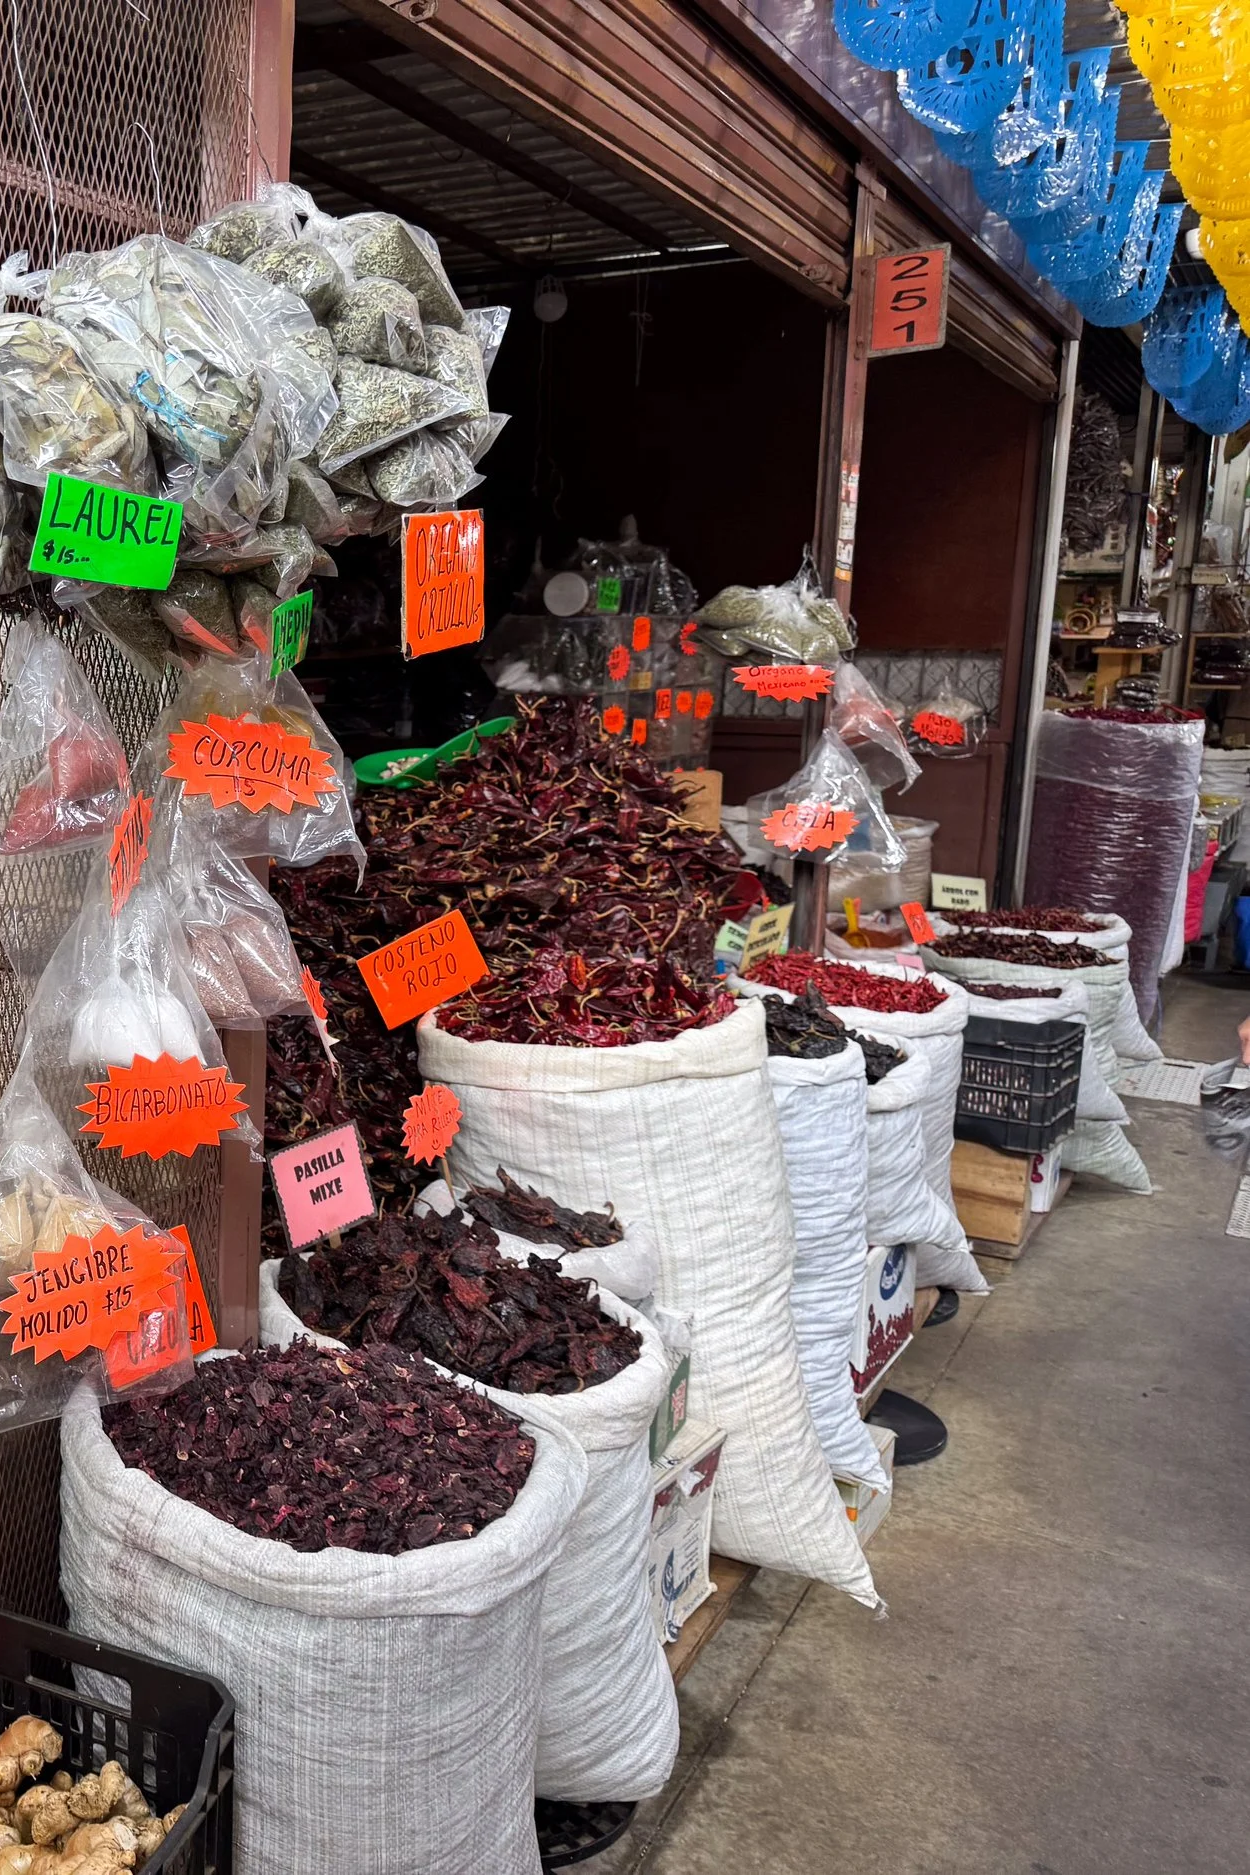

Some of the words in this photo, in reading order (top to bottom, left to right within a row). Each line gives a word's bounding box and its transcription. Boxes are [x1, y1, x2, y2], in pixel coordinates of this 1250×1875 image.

[890, 256, 929, 342] 251
[49, 478, 174, 545] LAUREL
[417, 576, 475, 639] CRIOLLO
[194, 735, 311, 785] CURCUMA
[373, 921, 455, 977] COSTEÑO
[403, 953, 457, 995] ROJO
[96, 1077, 226, 1125] BICARBONATO
[294, 1148, 345, 1182] PASILLA
[309, 1177, 343, 1205] MIXE
[23, 1244, 134, 1303] JENGIBRE
[102, 1285, 135, 1316] $15
